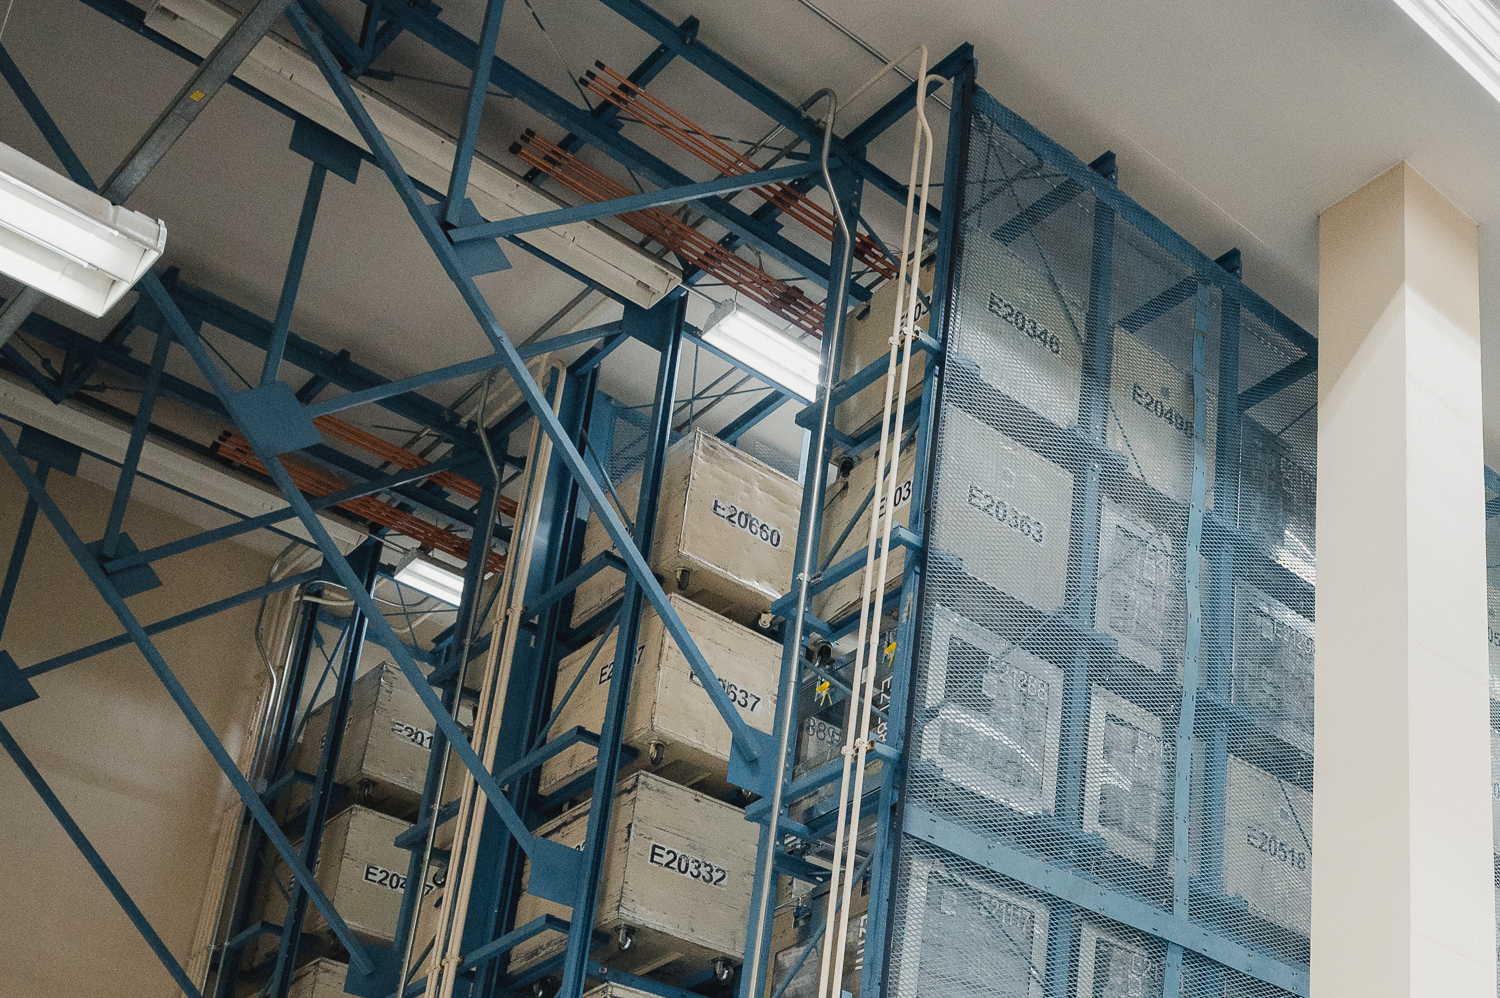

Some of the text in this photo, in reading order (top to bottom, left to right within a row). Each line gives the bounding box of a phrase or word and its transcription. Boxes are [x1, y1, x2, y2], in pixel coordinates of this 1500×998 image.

[989, 292, 1060, 356] E20346
[713, 499, 780, 548] E20660
[969, 483, 1045, 545] E20363
[650, 843, 728, 887] E20332
